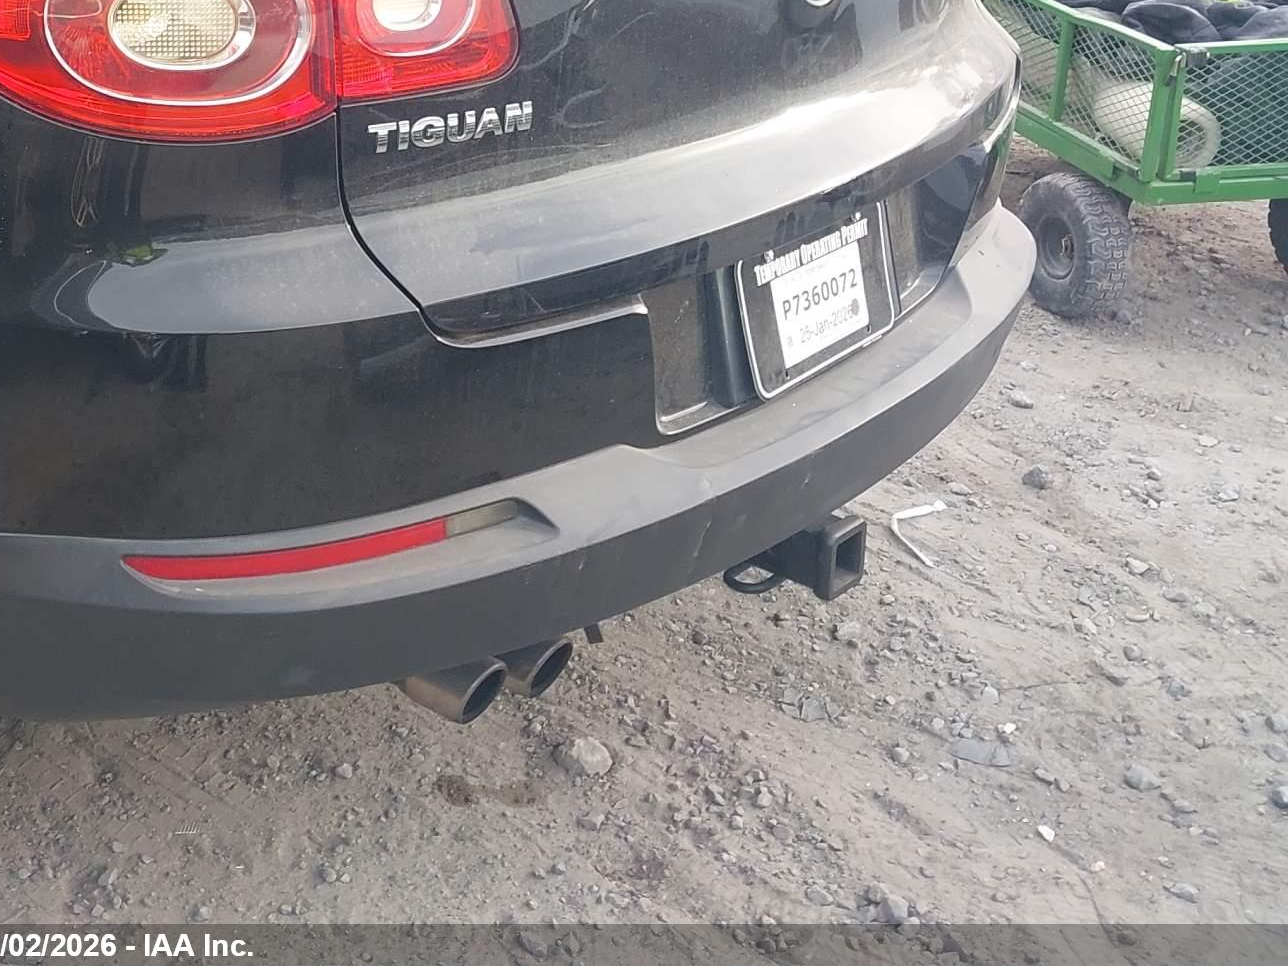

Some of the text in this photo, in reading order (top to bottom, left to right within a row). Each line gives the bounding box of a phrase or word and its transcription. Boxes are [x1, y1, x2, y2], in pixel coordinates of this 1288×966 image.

[368, 100, 533, 153] TIGUAN
[754, 249, 800, 286] TEMPORARY
[800, 231, 841, 265] OPERATING
[840, 218, 868, 246] PERMIT
[782, 268, 858, 321] P7360072
